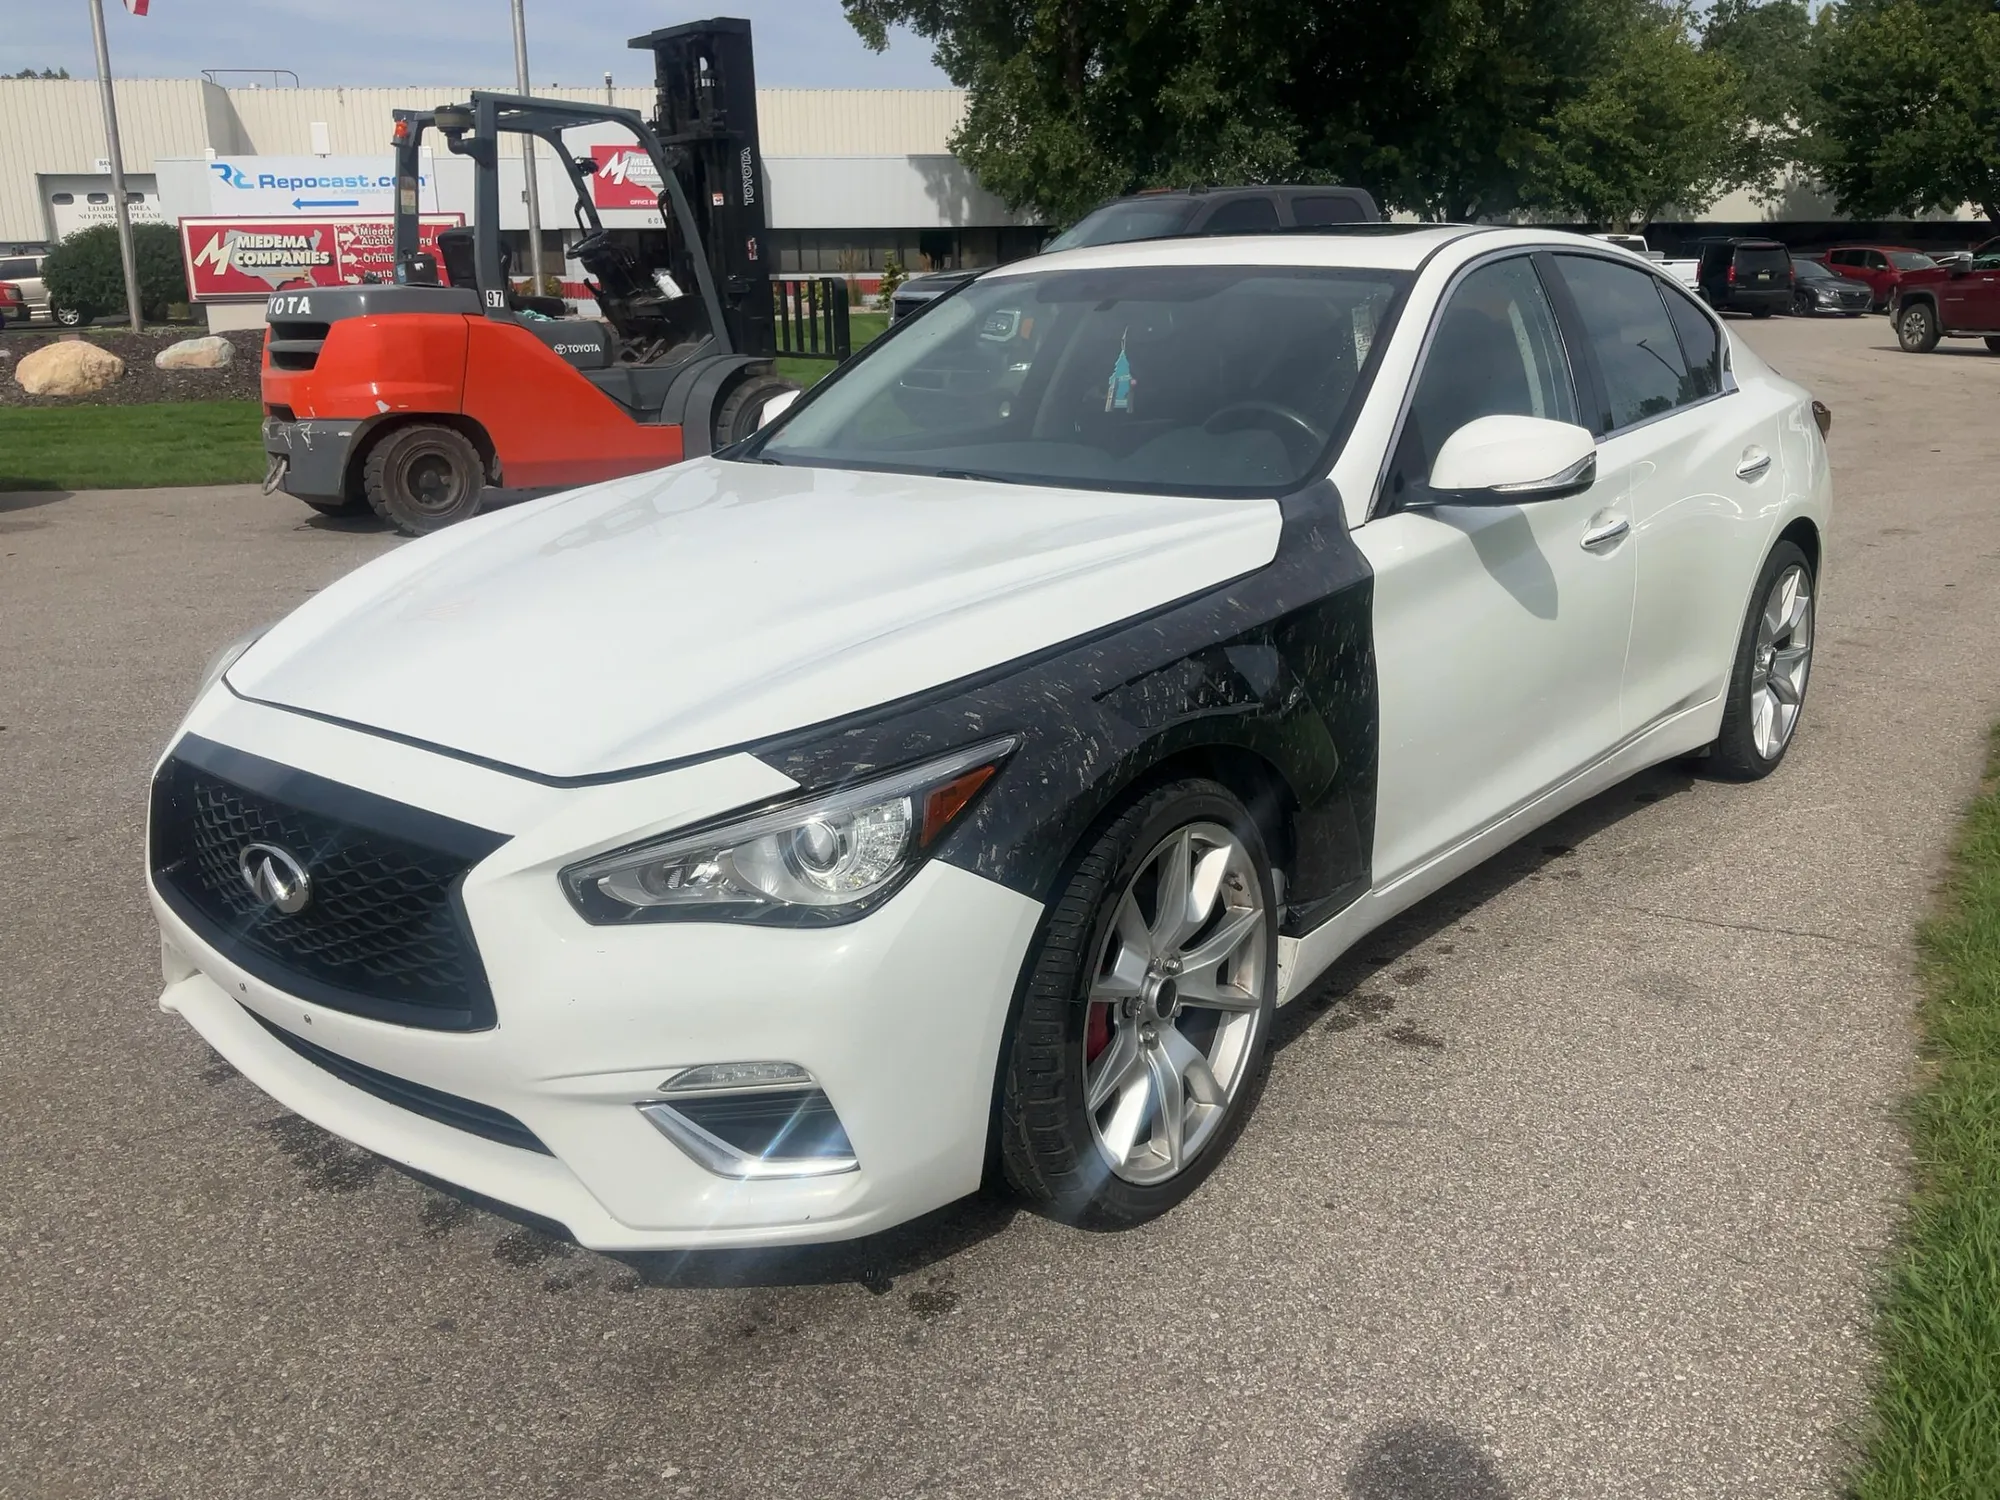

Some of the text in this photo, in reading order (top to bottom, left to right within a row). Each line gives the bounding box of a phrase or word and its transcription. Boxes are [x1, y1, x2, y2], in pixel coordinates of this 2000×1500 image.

[741, 147, 755, 206] TOYOTA
[237, 235, 308, 248] MIEDEMA
[234, 251, 330, 265] COMPANIES
[488, 292, 502, 306] 97
[567, 344, 600, 353] TOYOTA
